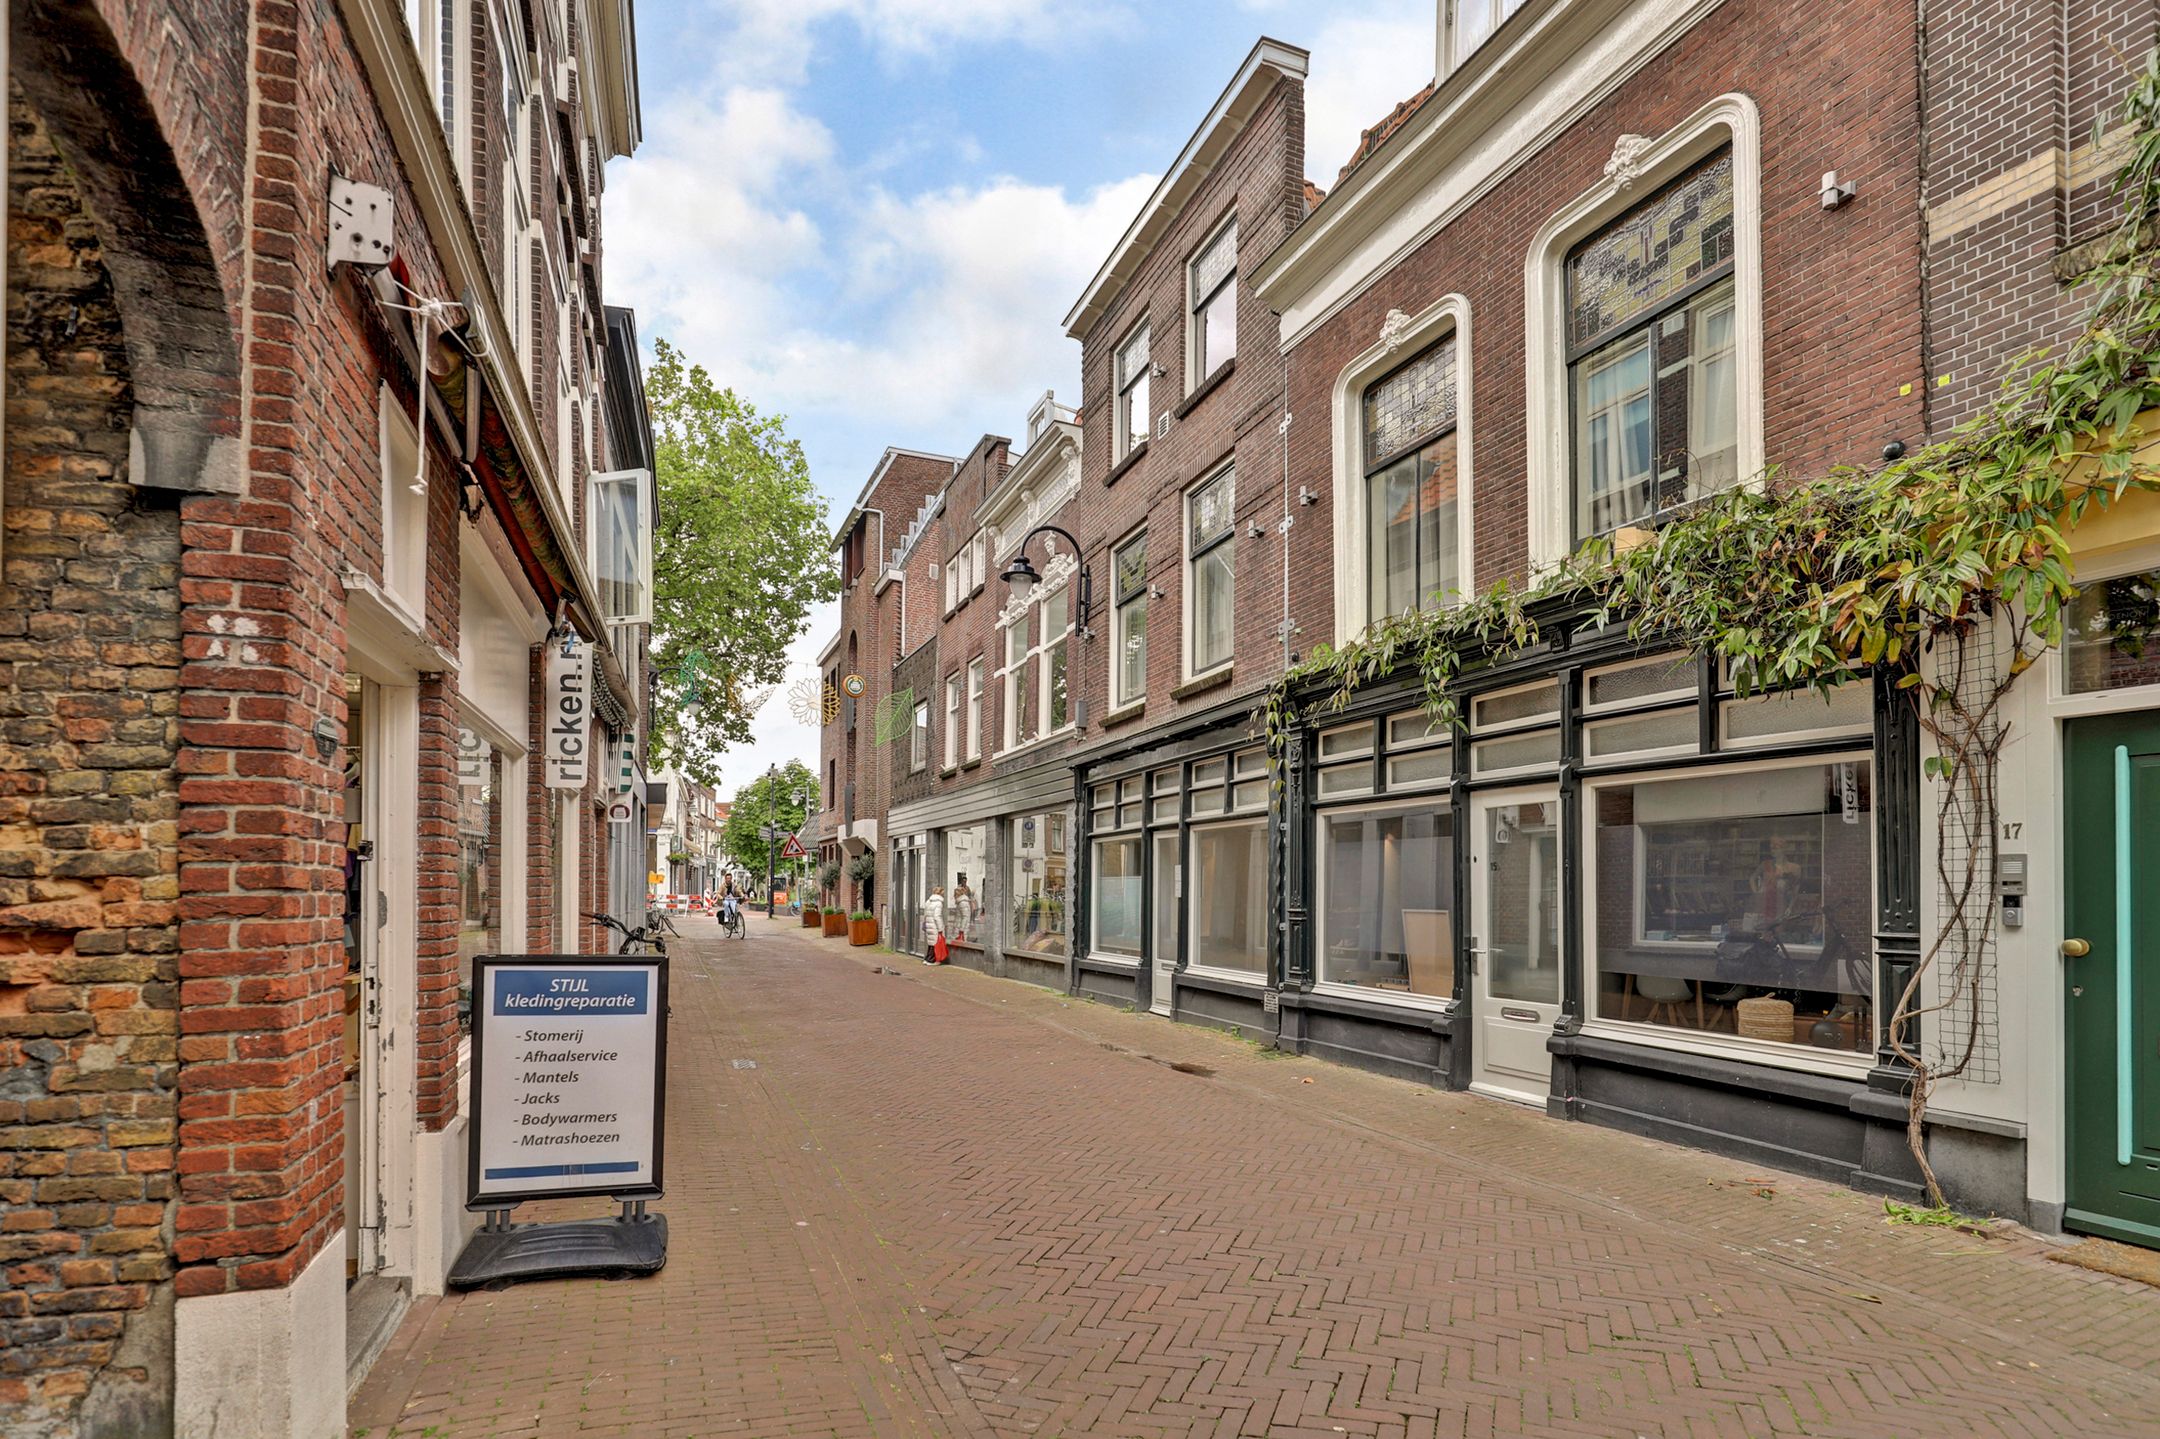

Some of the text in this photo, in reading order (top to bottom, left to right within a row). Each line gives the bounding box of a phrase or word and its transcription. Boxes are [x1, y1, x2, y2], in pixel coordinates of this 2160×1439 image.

[2003, 823, 2023, 840] 17
[550, 978, 590, 992] STIJL
[505, 993, 636, 1010] kledingreparatie
[524, 1029, 584, 1044] Stomerij
[522, 1049, 618, 1063] Afhaalservice
[522, 1070, 580, 1084] Mantels
[521, 1092, 561, 1105] Jacks
[521, 1112, 618, 1127] Bodywarmers
[520, 1132, 620, 1147] Matrashoezen
